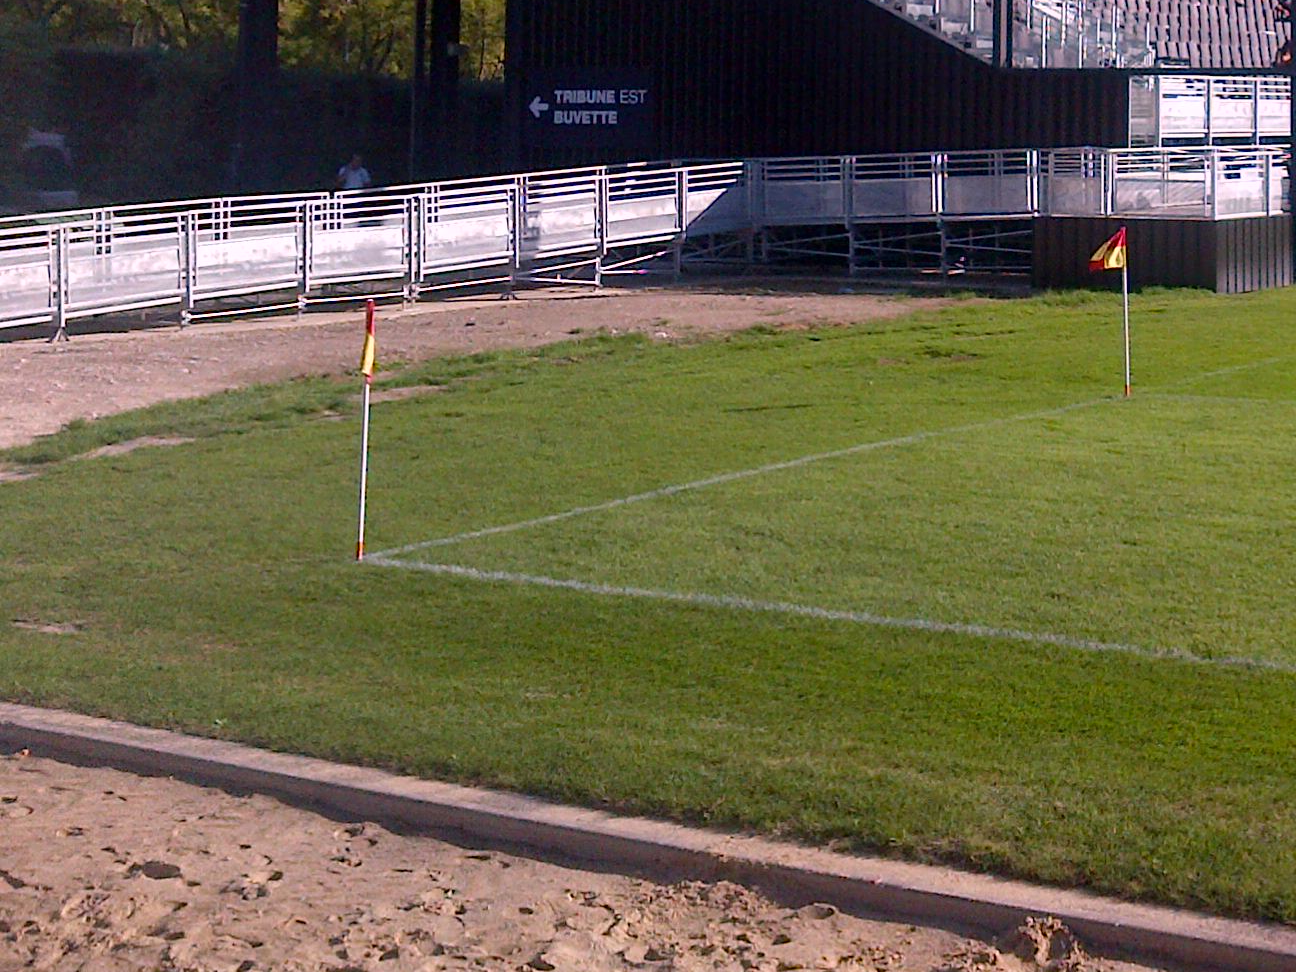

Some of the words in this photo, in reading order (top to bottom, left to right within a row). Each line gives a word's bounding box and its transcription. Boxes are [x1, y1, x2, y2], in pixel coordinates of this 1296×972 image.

[554, 90, 616, 104] TRIBUNE
[619, 90, 647, 104] EST
[554, 110, 618, 124] BUVETTE
